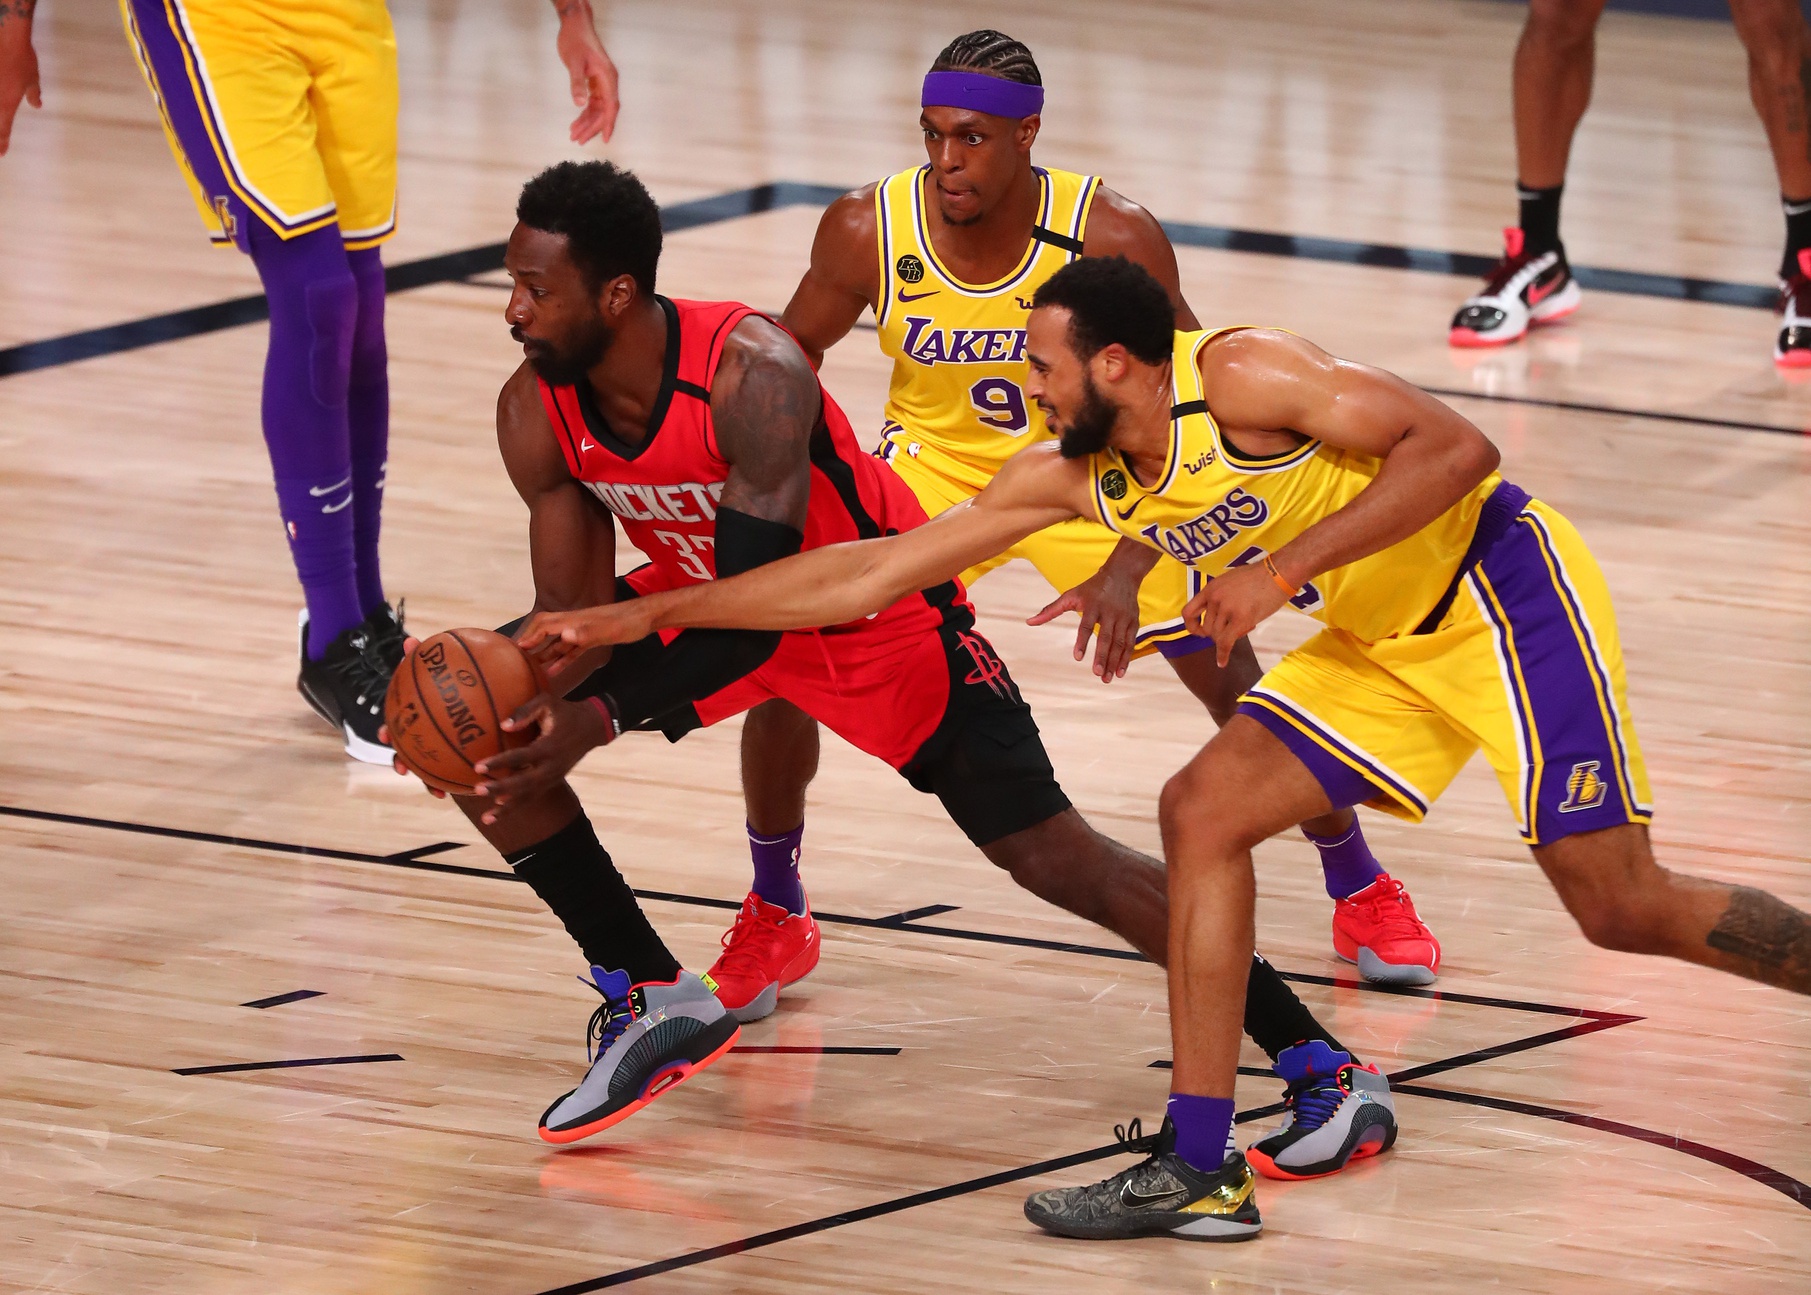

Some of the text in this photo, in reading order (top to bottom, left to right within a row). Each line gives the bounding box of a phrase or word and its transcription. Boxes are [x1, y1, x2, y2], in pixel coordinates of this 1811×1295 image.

[901, 315, 1028, 368] LAKER
[968, 376, 1030, 438] 9
[1183, 445, 1219, 475] wish
[1140, 485, 1270, 567] LAKERS
[418, 641, 487, 747] SPALDING
